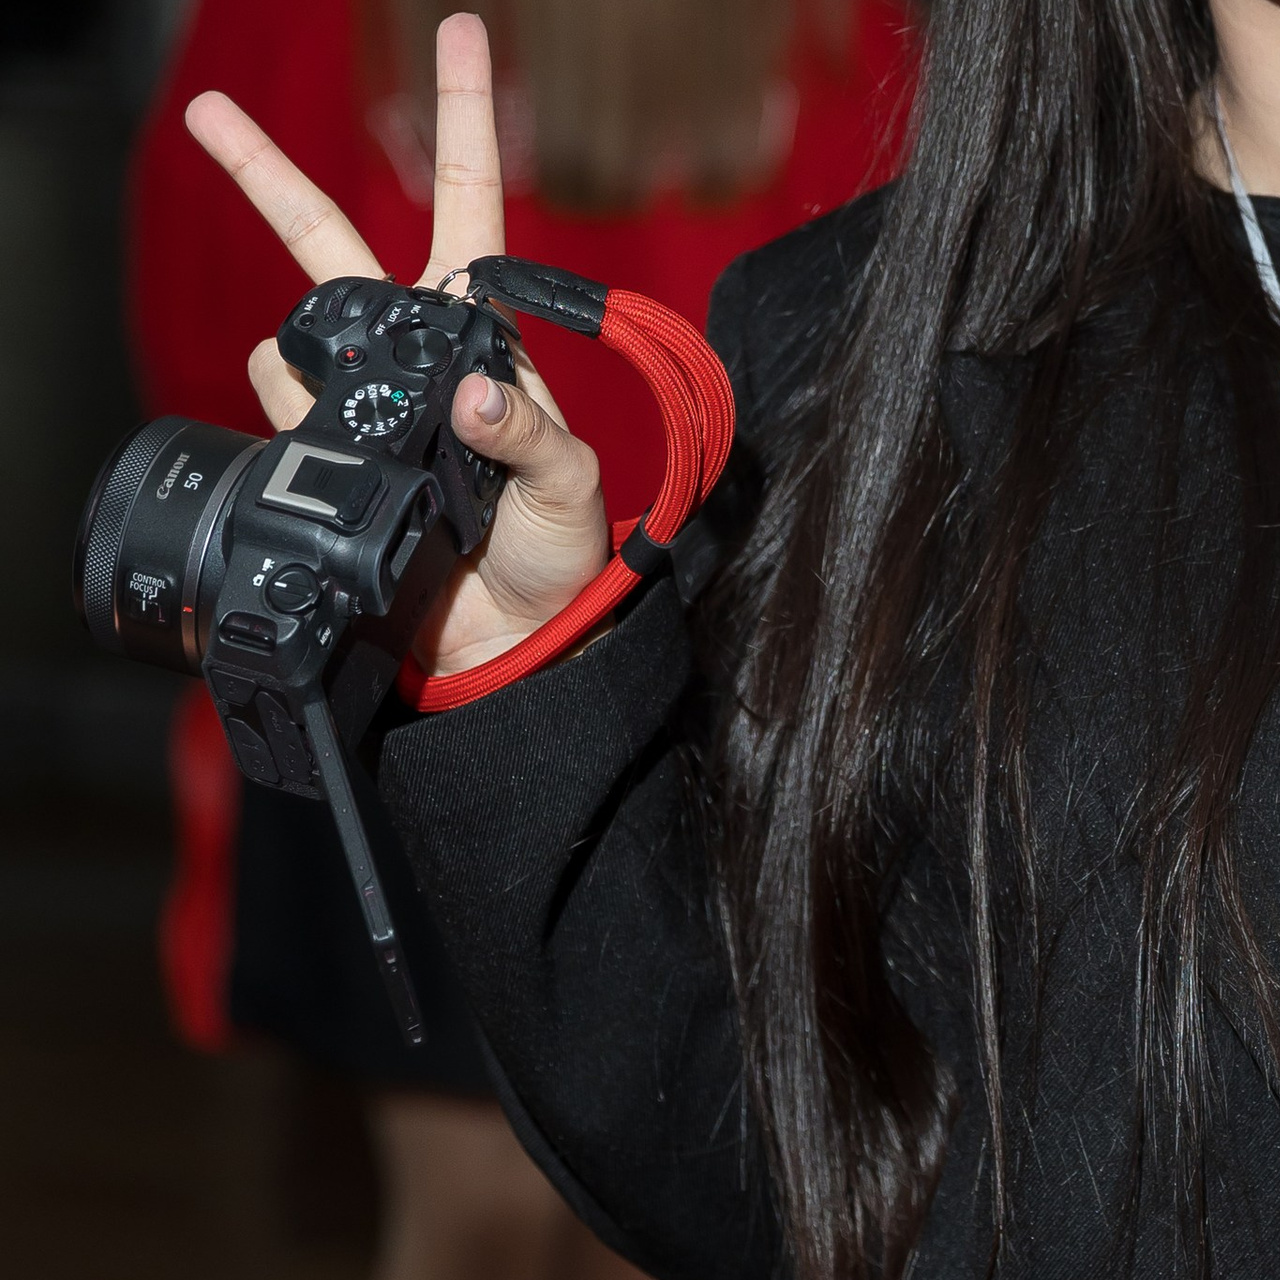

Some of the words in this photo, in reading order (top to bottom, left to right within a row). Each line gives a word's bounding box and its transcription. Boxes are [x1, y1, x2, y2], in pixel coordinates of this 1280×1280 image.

[388, 306, 401, 323] LOCK
[375, 323, 386, 335] OFF
[156, 452, 191, 500] Canon
[184, 472, 203, 491] 50
[129, 580, 154, 594] FOCUS
[132, 572, 167, 589] CONTROL
